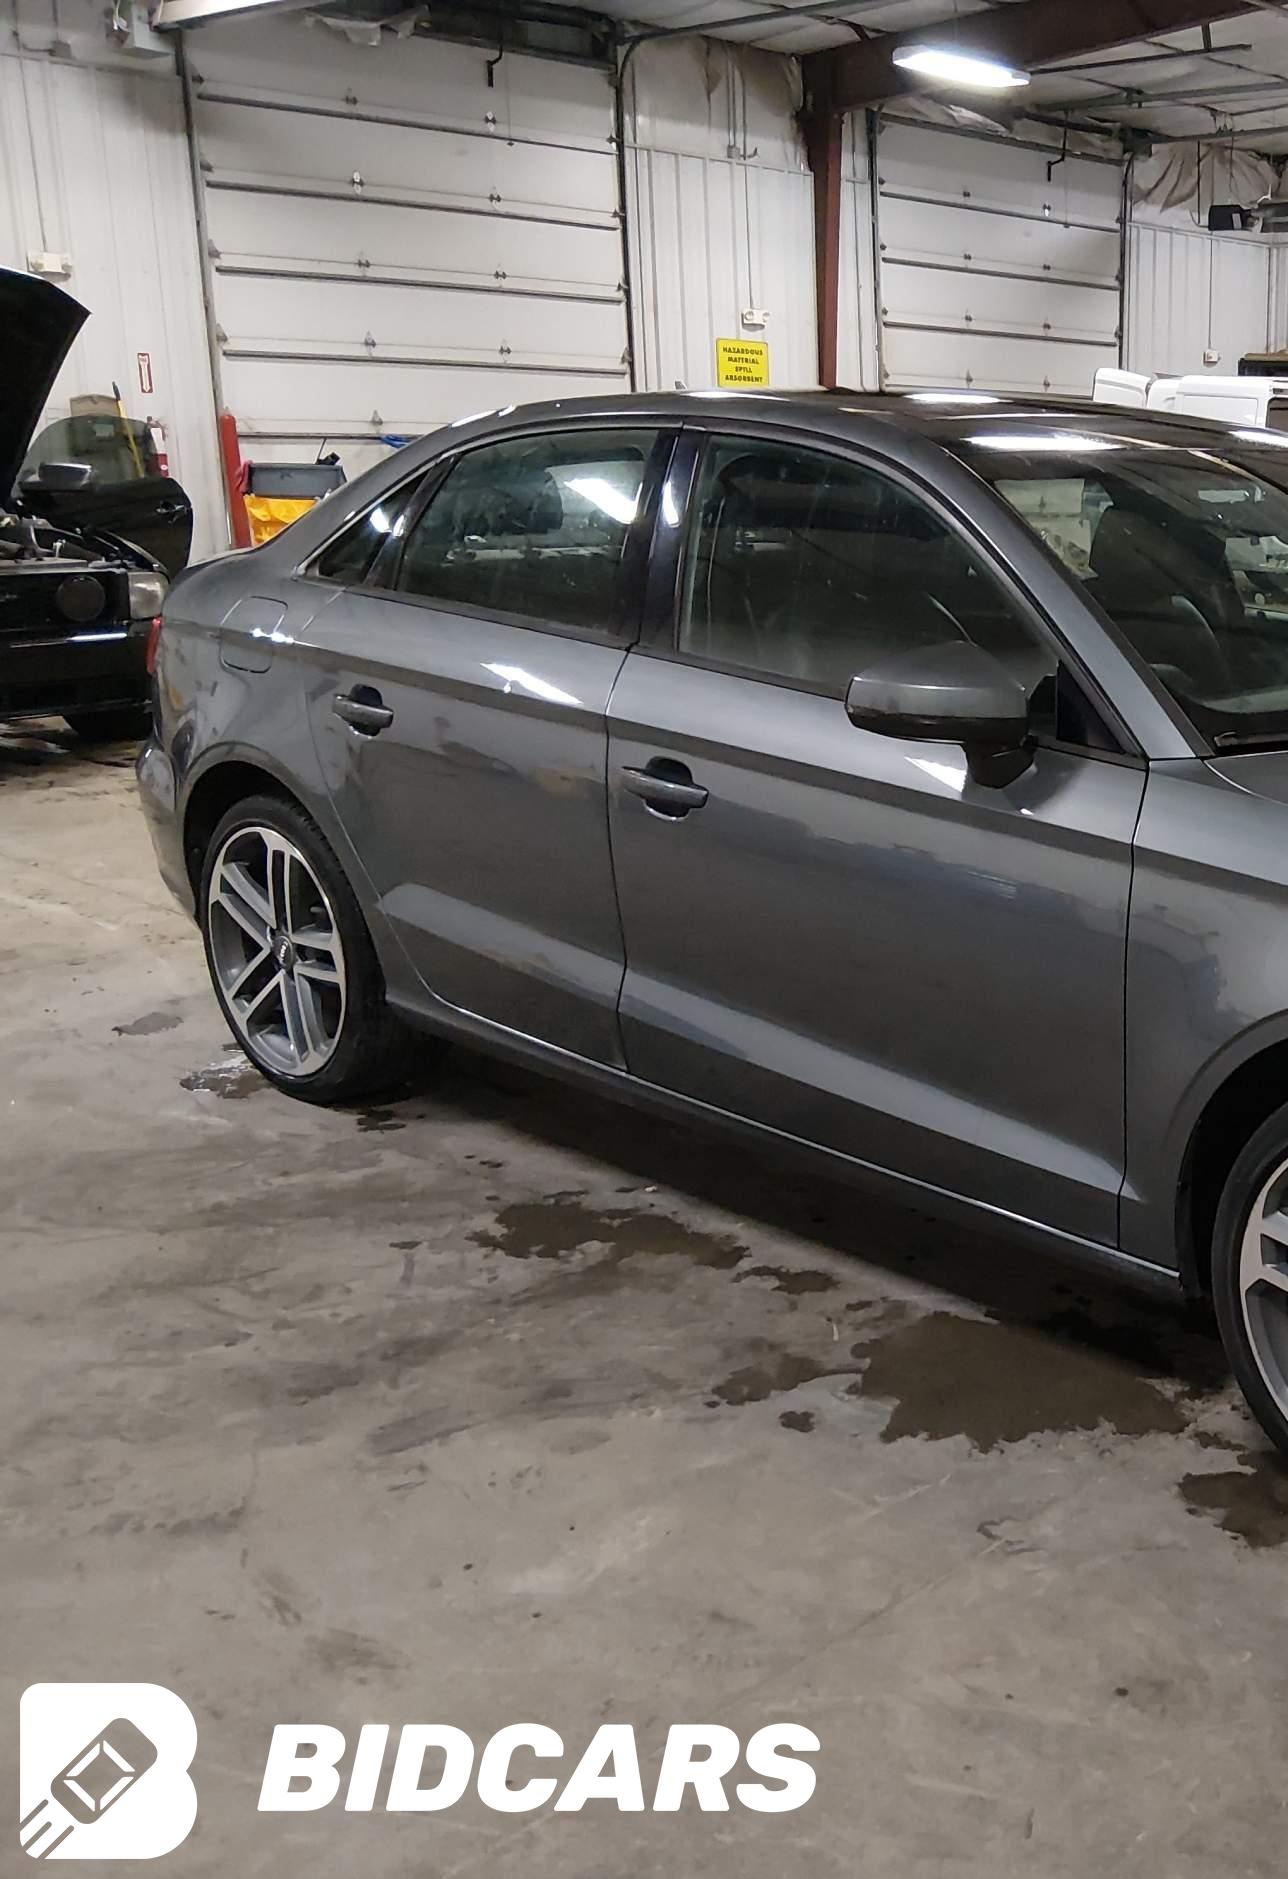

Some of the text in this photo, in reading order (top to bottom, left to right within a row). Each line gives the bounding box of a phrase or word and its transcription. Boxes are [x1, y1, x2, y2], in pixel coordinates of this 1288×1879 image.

[723, 347, 763, 356] HAZARDOUS
[728, 356, 759, 365] MATERIAL
[725, 375, 763, 383] ABSORBENT
